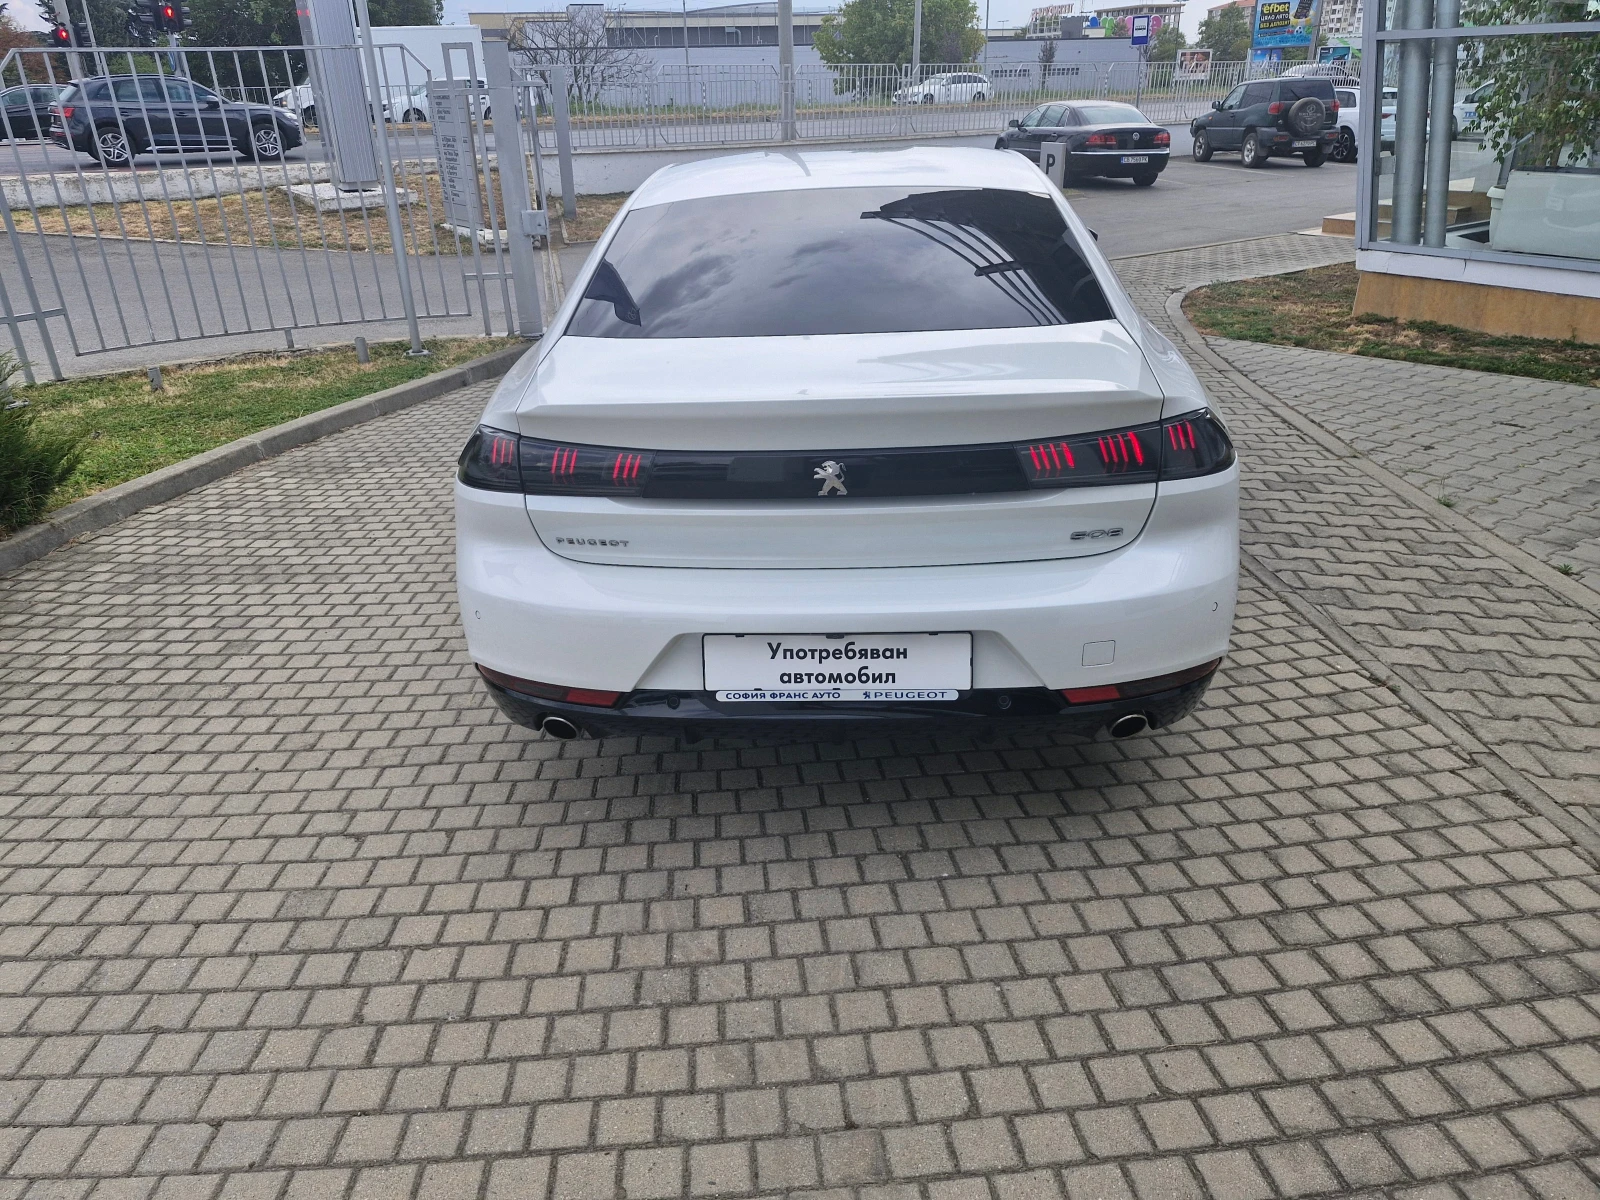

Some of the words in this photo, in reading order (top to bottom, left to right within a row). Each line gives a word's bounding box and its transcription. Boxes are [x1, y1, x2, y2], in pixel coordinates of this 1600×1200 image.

[1263, 3, 1289, 14] efbet
[1046, 154, 1055, 174] P
[1070, 527, 1124, 540] 508
[555, 536, 630, 547] PEUGEOT
[767, 642, 908, 664] Употребяван
[779, 666, 896, 684] автомобил
[725, 692, 766, 700] СОФИЯ
[769, 691, 809, 700] ФРАНС
[811, 691, 841, 700] АУТО
[874, 691, 948, 699] PEUGEOT
